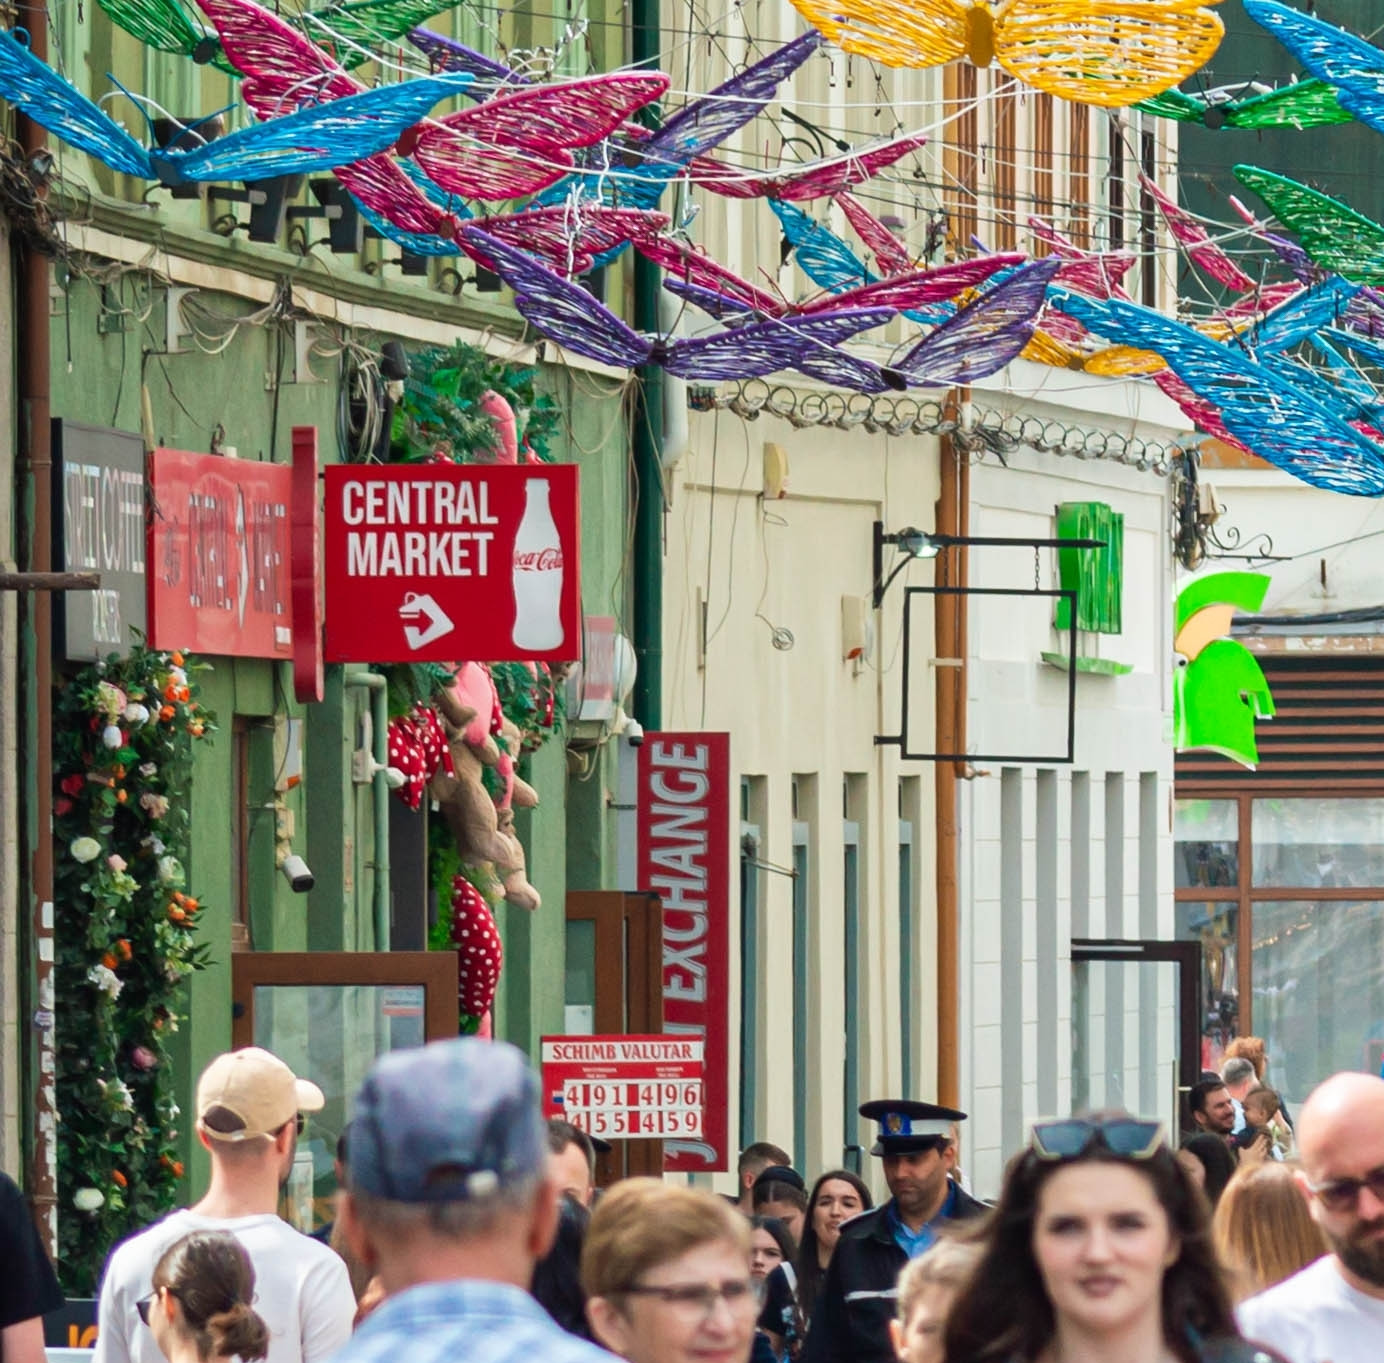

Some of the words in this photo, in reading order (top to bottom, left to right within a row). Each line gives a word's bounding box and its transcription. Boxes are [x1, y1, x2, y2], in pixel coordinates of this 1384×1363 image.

[342, 480, 499, 525] CENTRAL
[347, 531, 494, 577] MARKET
[650, 741, 709, 1002] EXCHANGE
[552, 1044, 616, 1060] SCHIMB
[621, 1044, 693, 1060] VALUTAR
